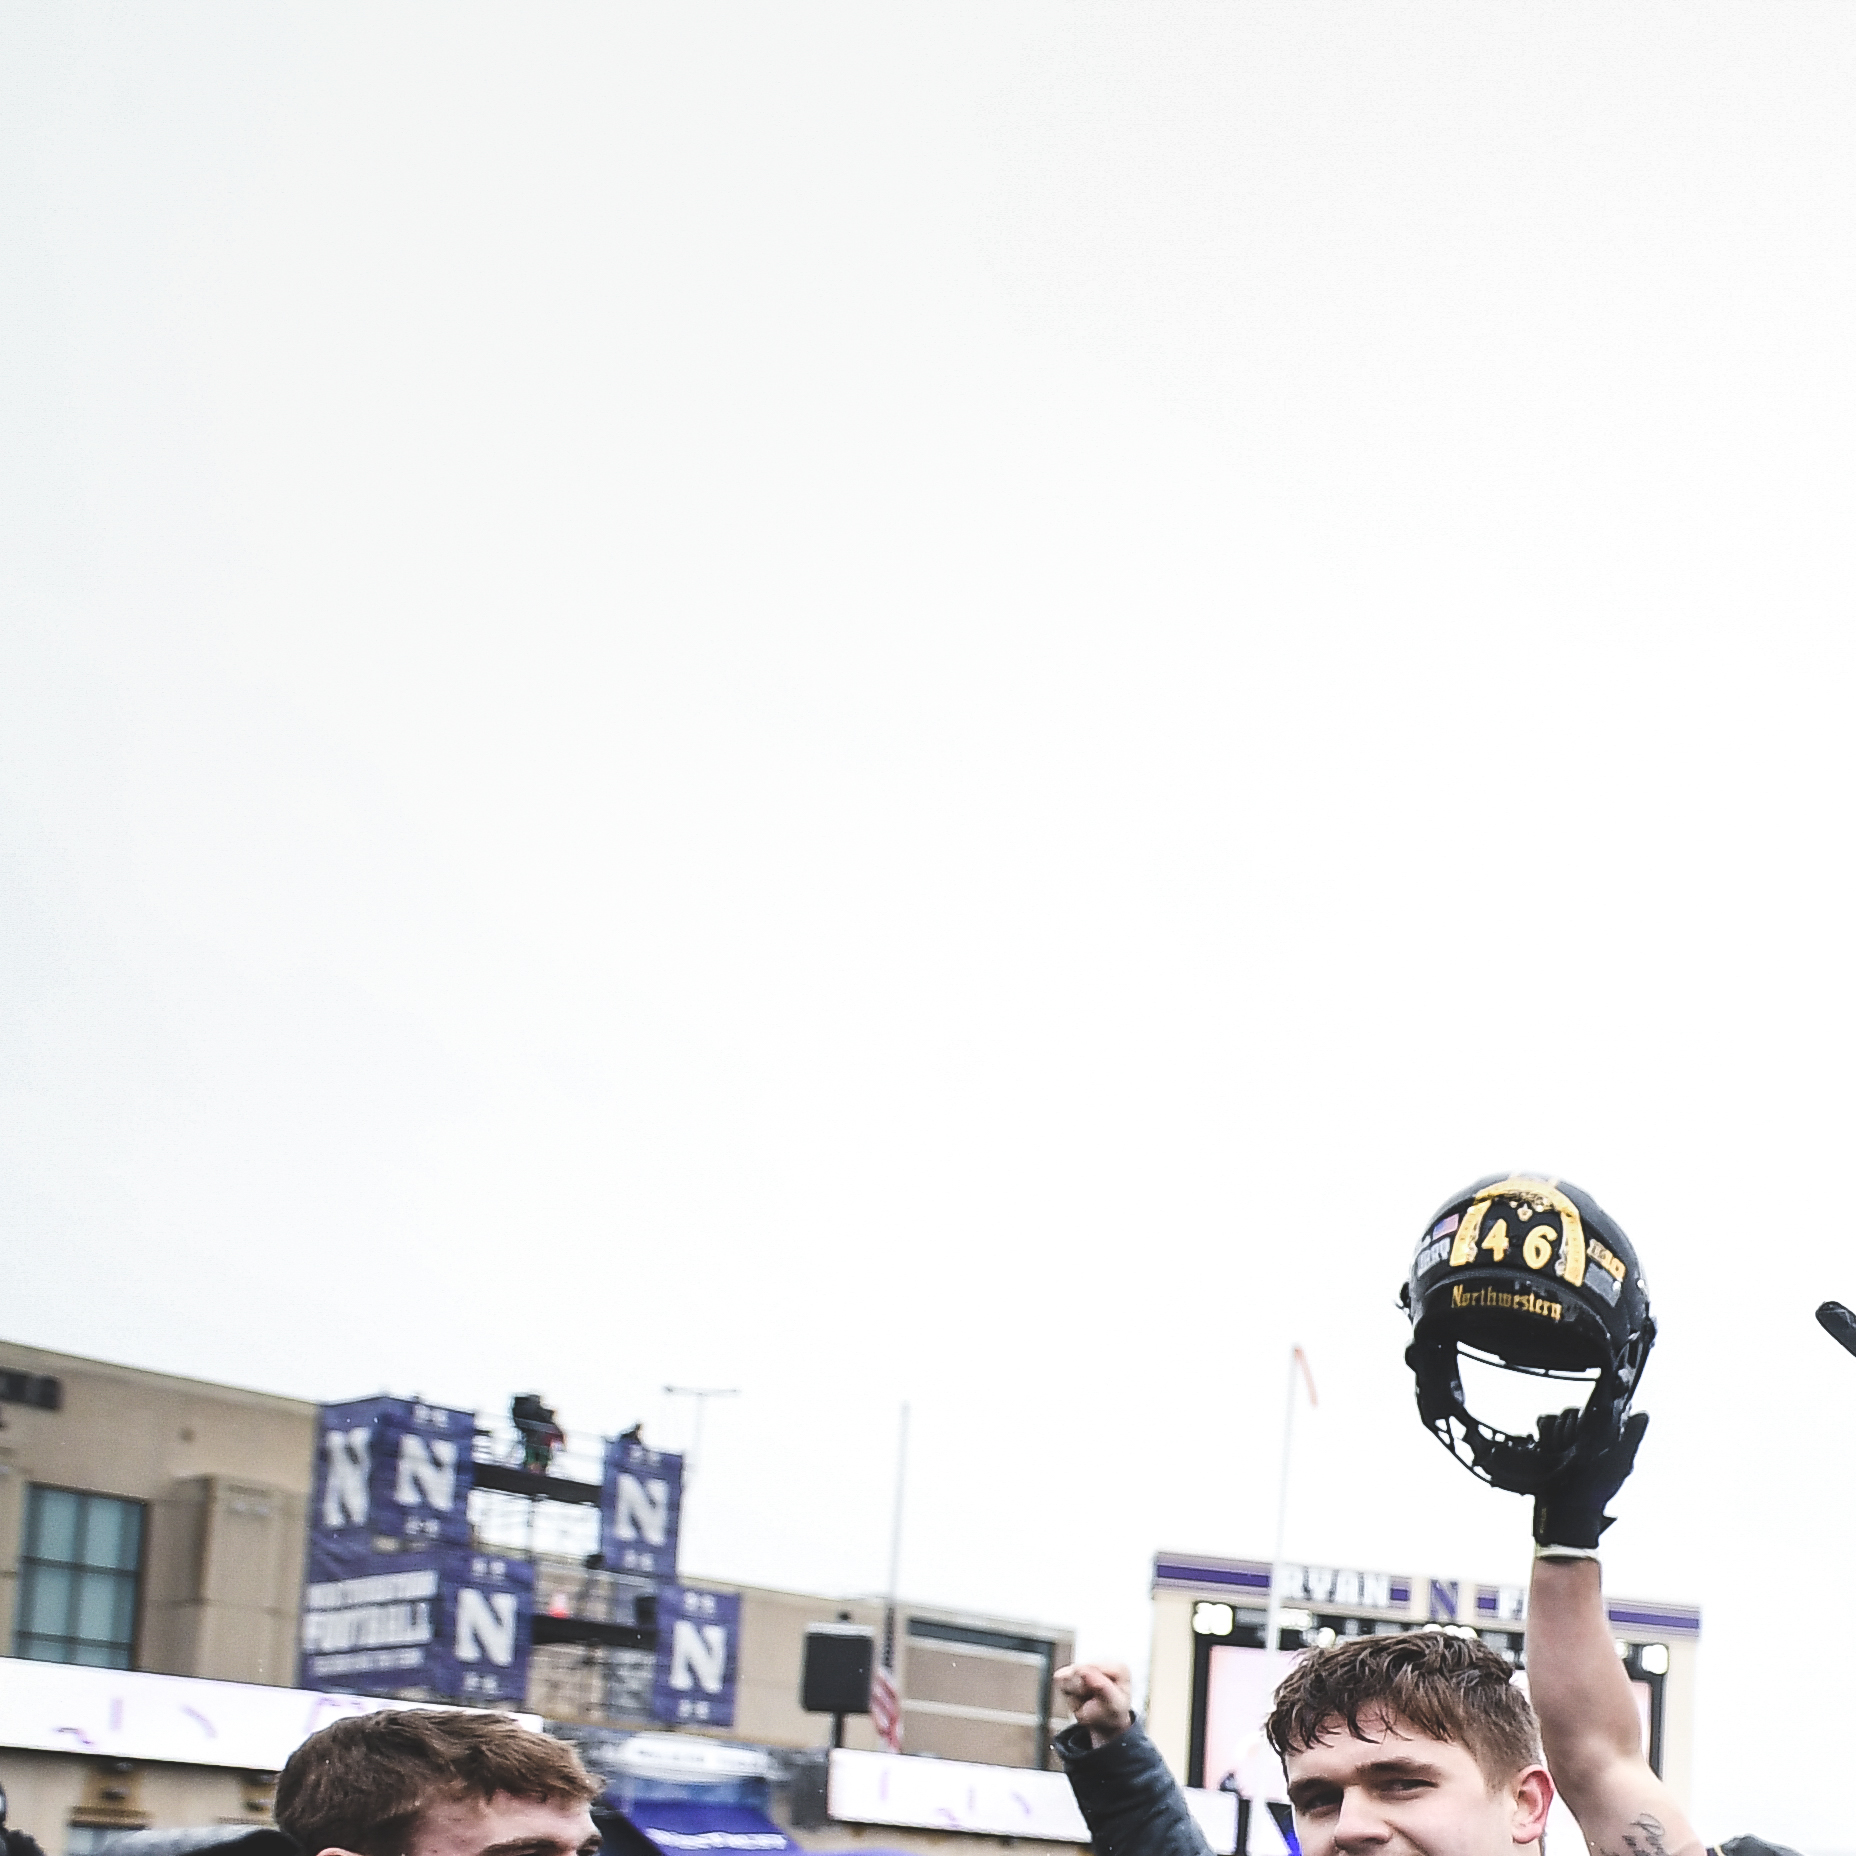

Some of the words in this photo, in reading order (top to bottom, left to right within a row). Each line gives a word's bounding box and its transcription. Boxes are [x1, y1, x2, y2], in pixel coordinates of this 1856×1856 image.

[1481, 1218, 1558, 1270] 46
[1452, 1284, 1562, 1322] Northwestern
[323, 1427, 372, 1530] N
[394, 1432, 459, 1512] N
[613, 1472, 670, 1547] N
[454, 1587, 518, 1668] N
[670, 1619, 729, 1694] N
